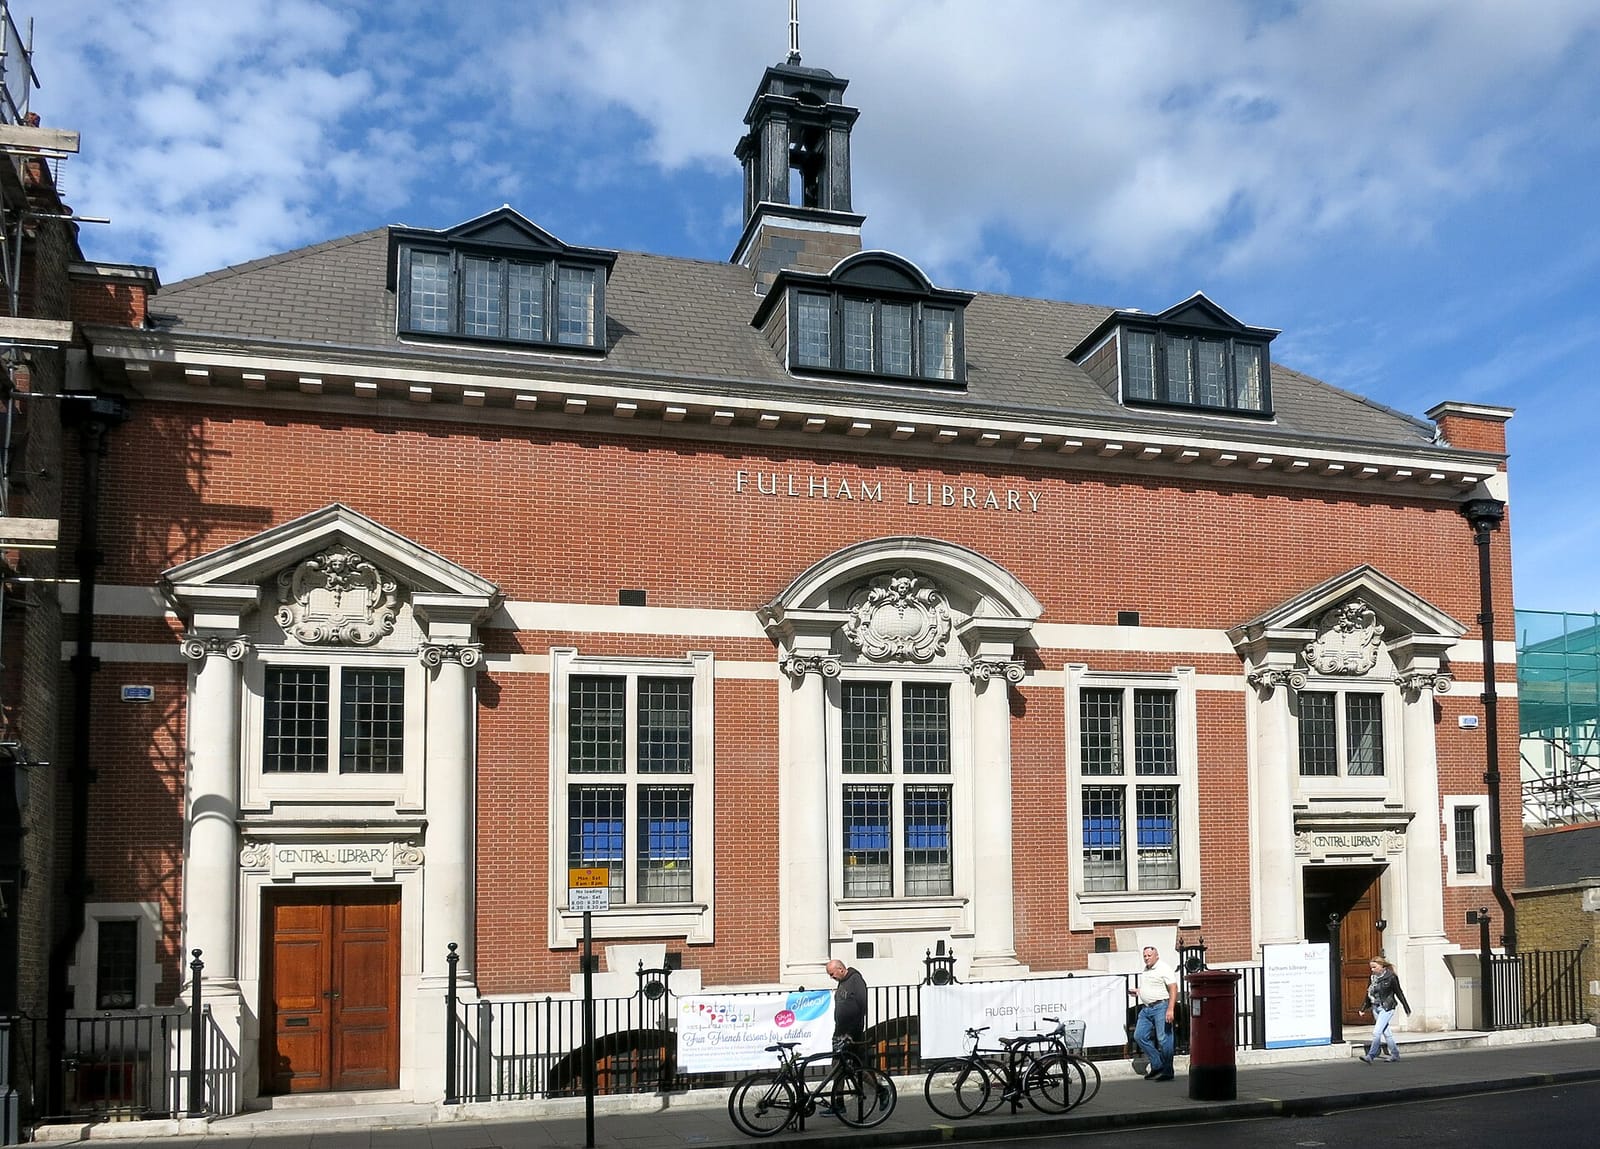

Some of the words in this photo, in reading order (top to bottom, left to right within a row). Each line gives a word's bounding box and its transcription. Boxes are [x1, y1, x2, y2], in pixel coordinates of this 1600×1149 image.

[736, 470, 883, 501] FULHAM
[907, 482, 1042, 512] LIBRARY
[1314, 836, 1350, 848] CENTRAL
[1351, 835, 1381, 847] LIBRARY
[278, 849, 335, 864] CENTRAL
[337, 848, 386, 863] LIBRARY
[682, 1000, 696, 1013] et
[699, 1000, 735, 1016] patati
[710, 1007, 756, 1025] patata!
[985, 1006, 1019, 1017] RUGBY
[1033, 1003, 1067, 1014] GREEN
[682, 1031, 706, 1046] Fun
[707, 1031, 741, 1046] French
[743, 1031, 768, 1042] lessons
[784, 1028, 812, 1039] children
